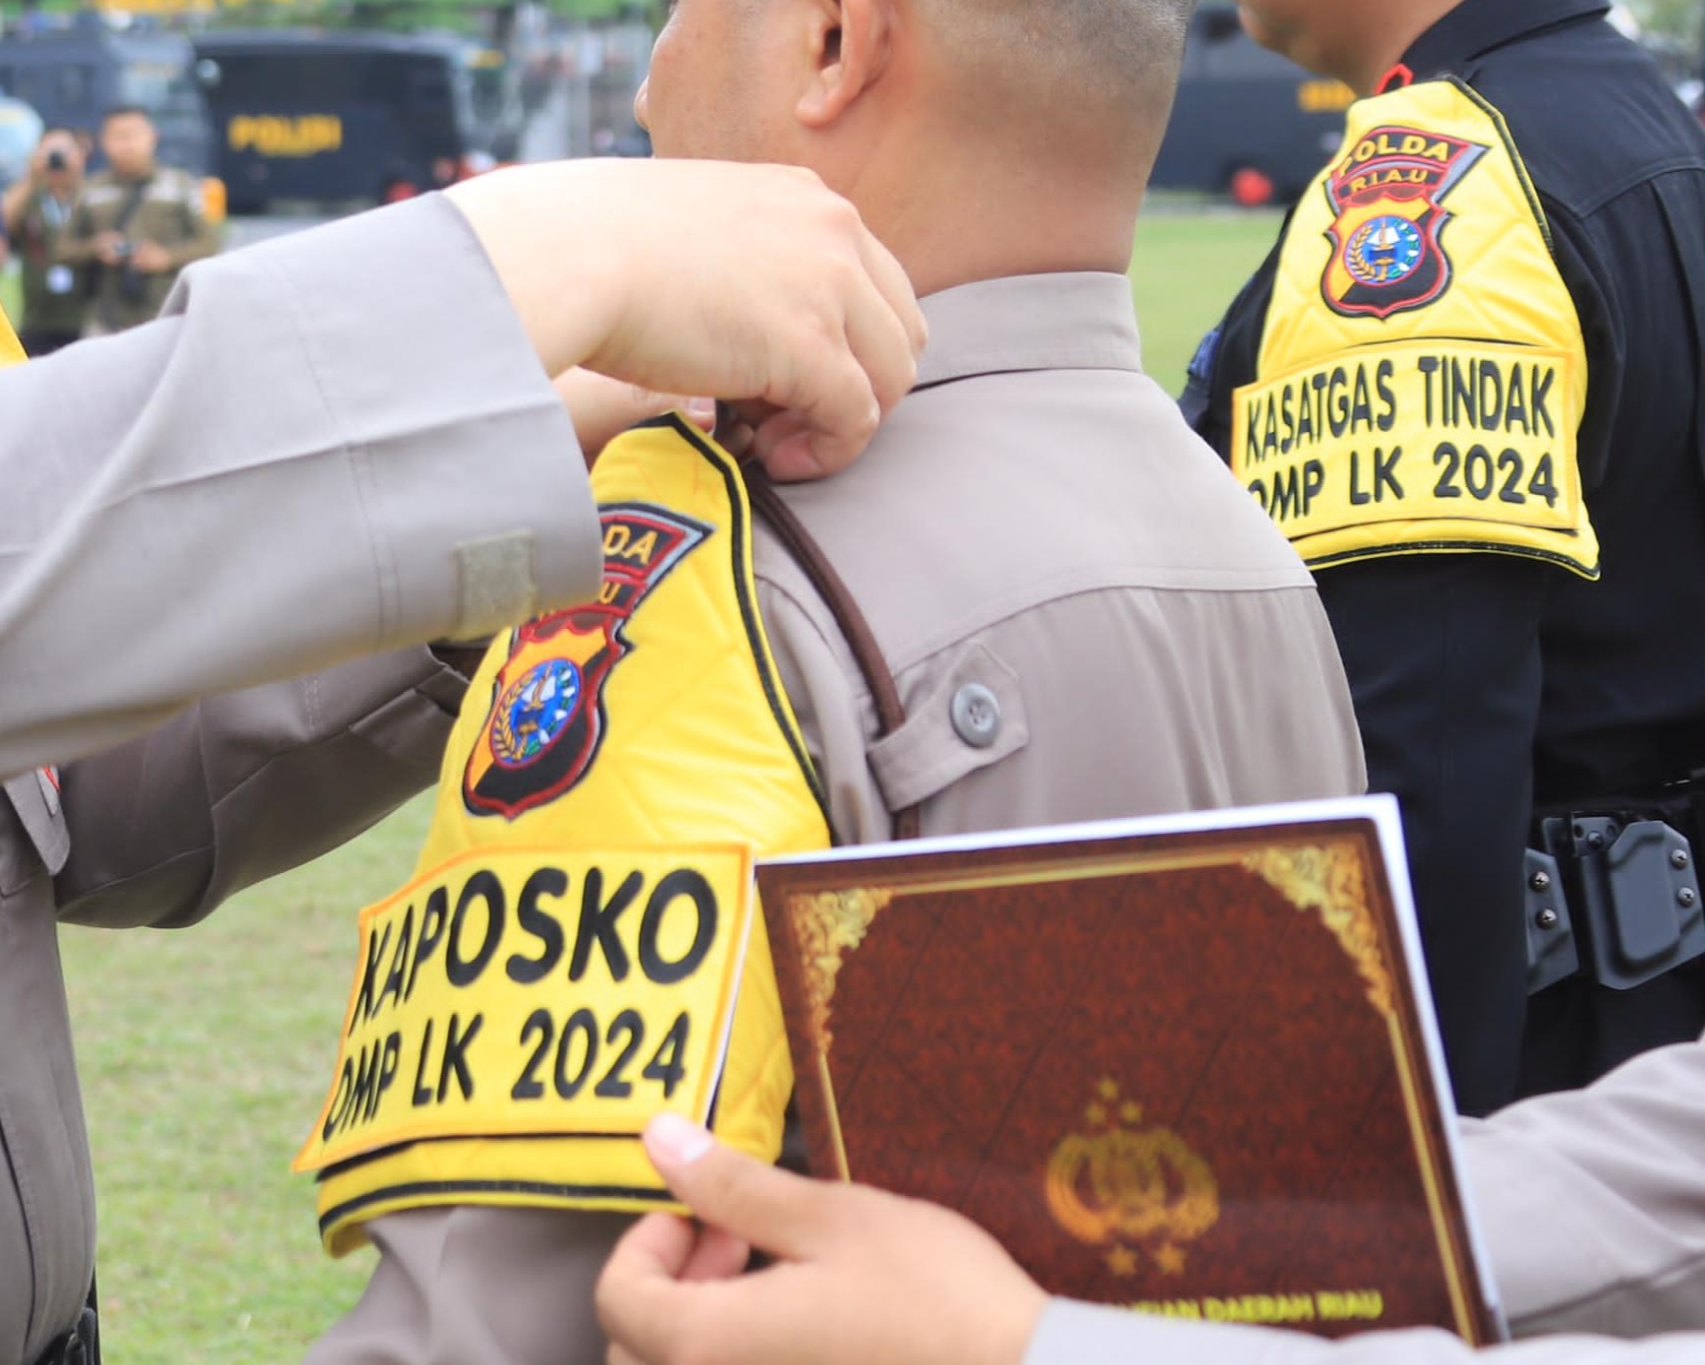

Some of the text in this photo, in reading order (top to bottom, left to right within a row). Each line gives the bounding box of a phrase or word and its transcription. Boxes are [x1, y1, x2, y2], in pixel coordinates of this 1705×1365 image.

[1350, 168, 1428, 193] RIAU
[1246, 355, 1554, 468] KASATGAS TINDAK
[1350, 446, 1404, 505] LK
[1433, 442, 1558, 508] 2024
[348, 867, 718, 1038] KAPOSKO
[411, 1012, 484, 1107] LK
[510, 1008, 690, 1101] 2024
